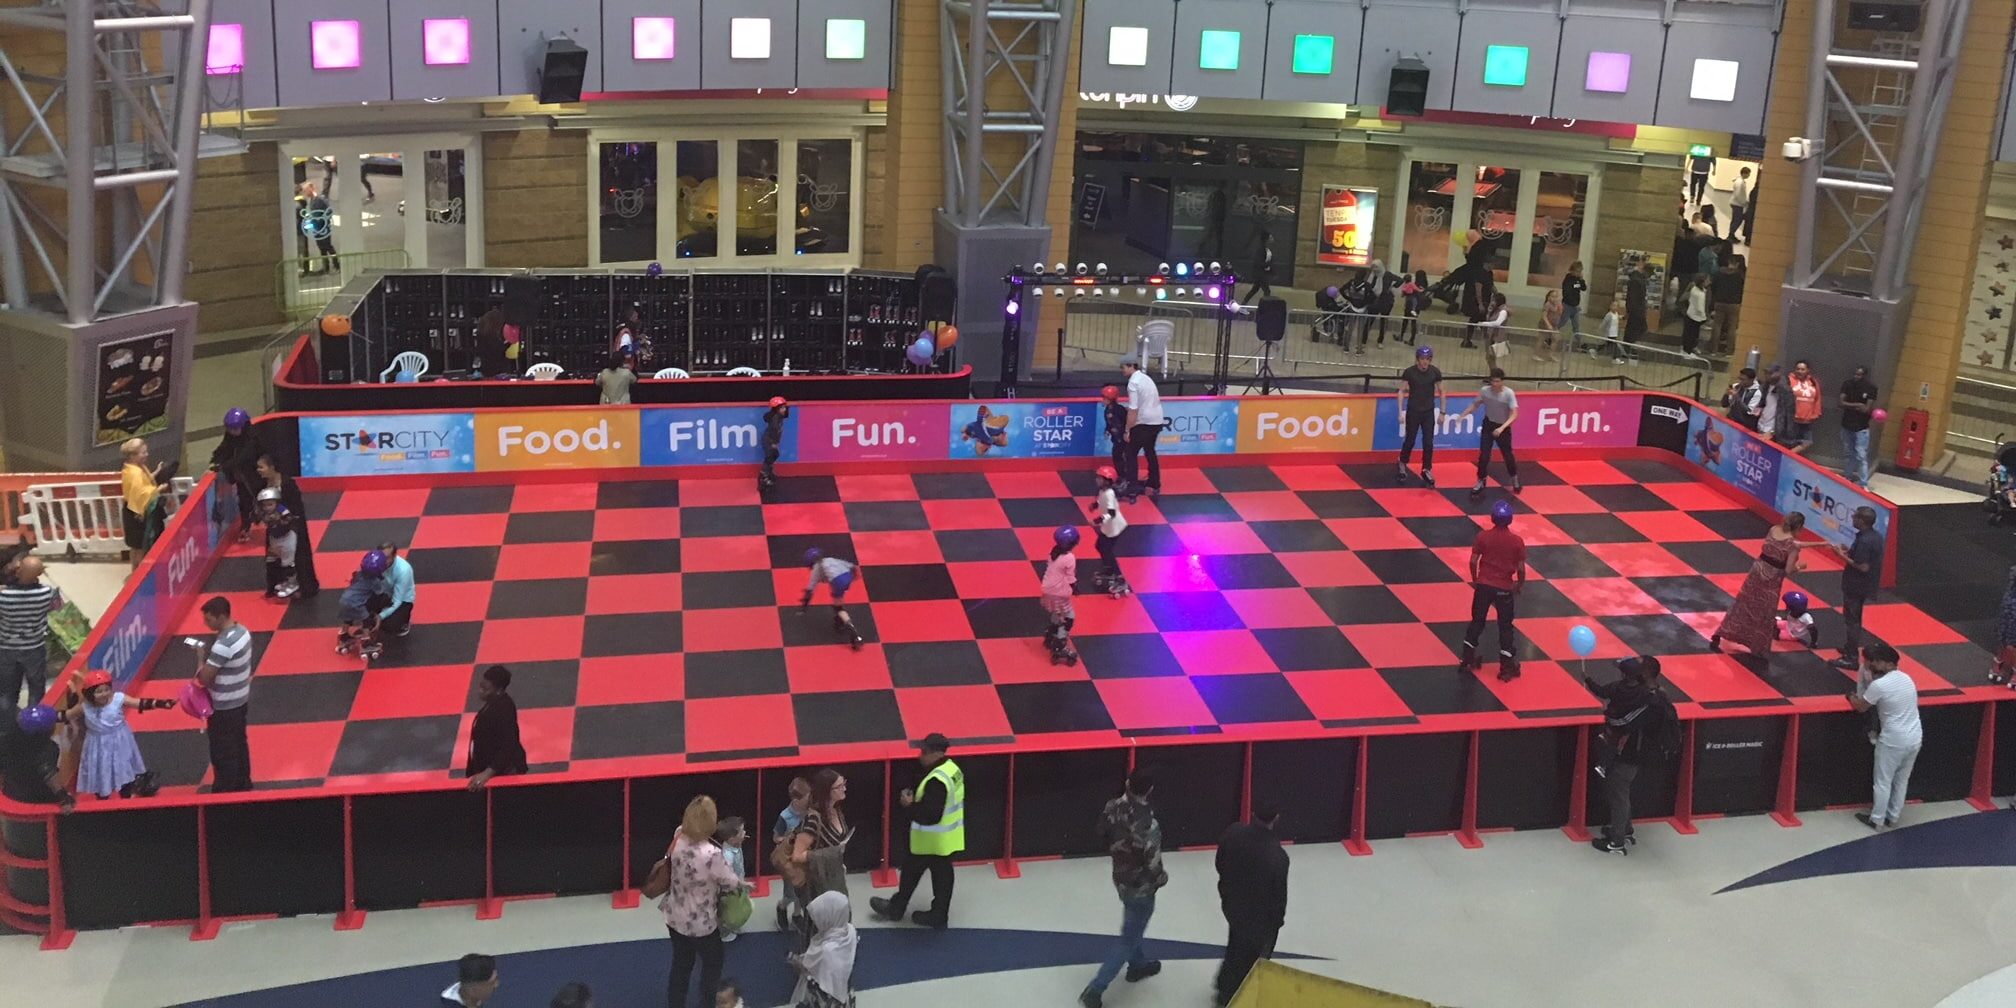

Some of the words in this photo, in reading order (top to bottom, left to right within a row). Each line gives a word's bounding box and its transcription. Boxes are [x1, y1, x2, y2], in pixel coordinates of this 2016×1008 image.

[1023, 415, 1084, 428] ROLLER
[1257, 407, 1359, 440] Food.
[1537, 407, 1612, 436] Fun.
[1653, 407, 1667, 415] ONE
[498, 418, 621, 457] Food.
[832, 418, 917, 448] Fun.
[1033, 429, 1073, 441] STAR
[1731, 442, 1772, 474] ROLLER
[1736, 459, 1763, 484] STAR
[168, 536, 200, 599] Fun.
[103, 614, 148, 679] Film.
